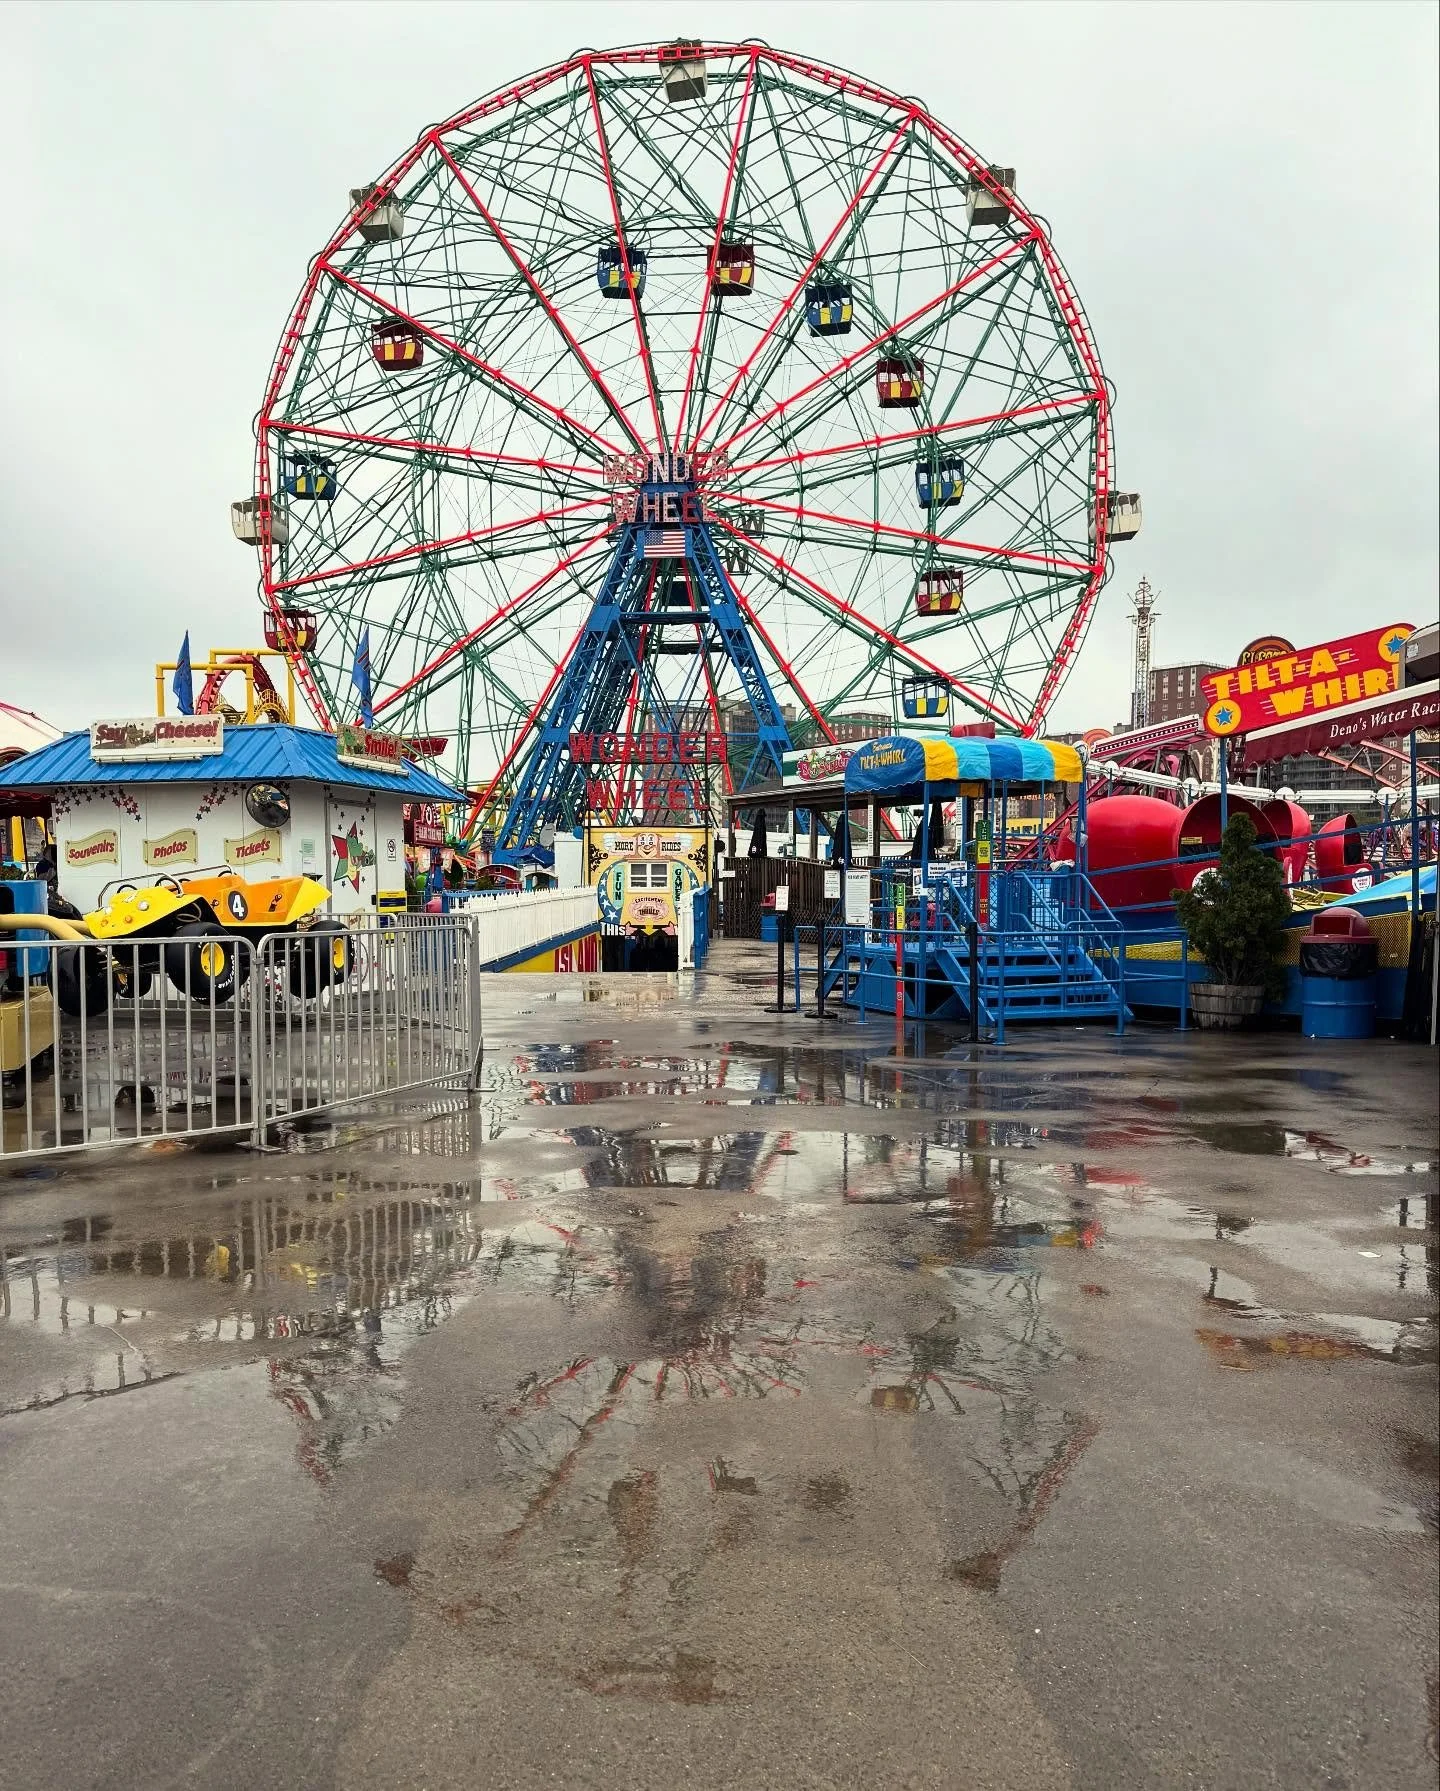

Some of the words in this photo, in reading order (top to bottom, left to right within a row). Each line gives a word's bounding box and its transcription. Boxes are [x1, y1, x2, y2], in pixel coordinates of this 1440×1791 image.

[603, 452, 728, 484] WONDER
[612, 492, 719, 523] WHEEL
[96, 724, 127, 744] Say
[155, 720, 219, 739] Cheese!
[1330, 717, 1367, 738] Deno's
[1371, 709, 1408, 728] Water
[365, 734, 397, 758] Smile!
[569, 732, 727, 764] WONDER
[860, 748, 906, 771] TILT-A-WHIRL
[586, 779, 709, 811] WHEEL
[69, 839, 115, 860] Souvenirs
[153, 839, 188, 859] Photos
[235, 838, 270, 858] Tickets
[615, 841, 634, 851] MORE
[661, 842, 681, 851] RIDES
[233, 895, 244, 917] 4
[600, 921, 626, 936] THIS
